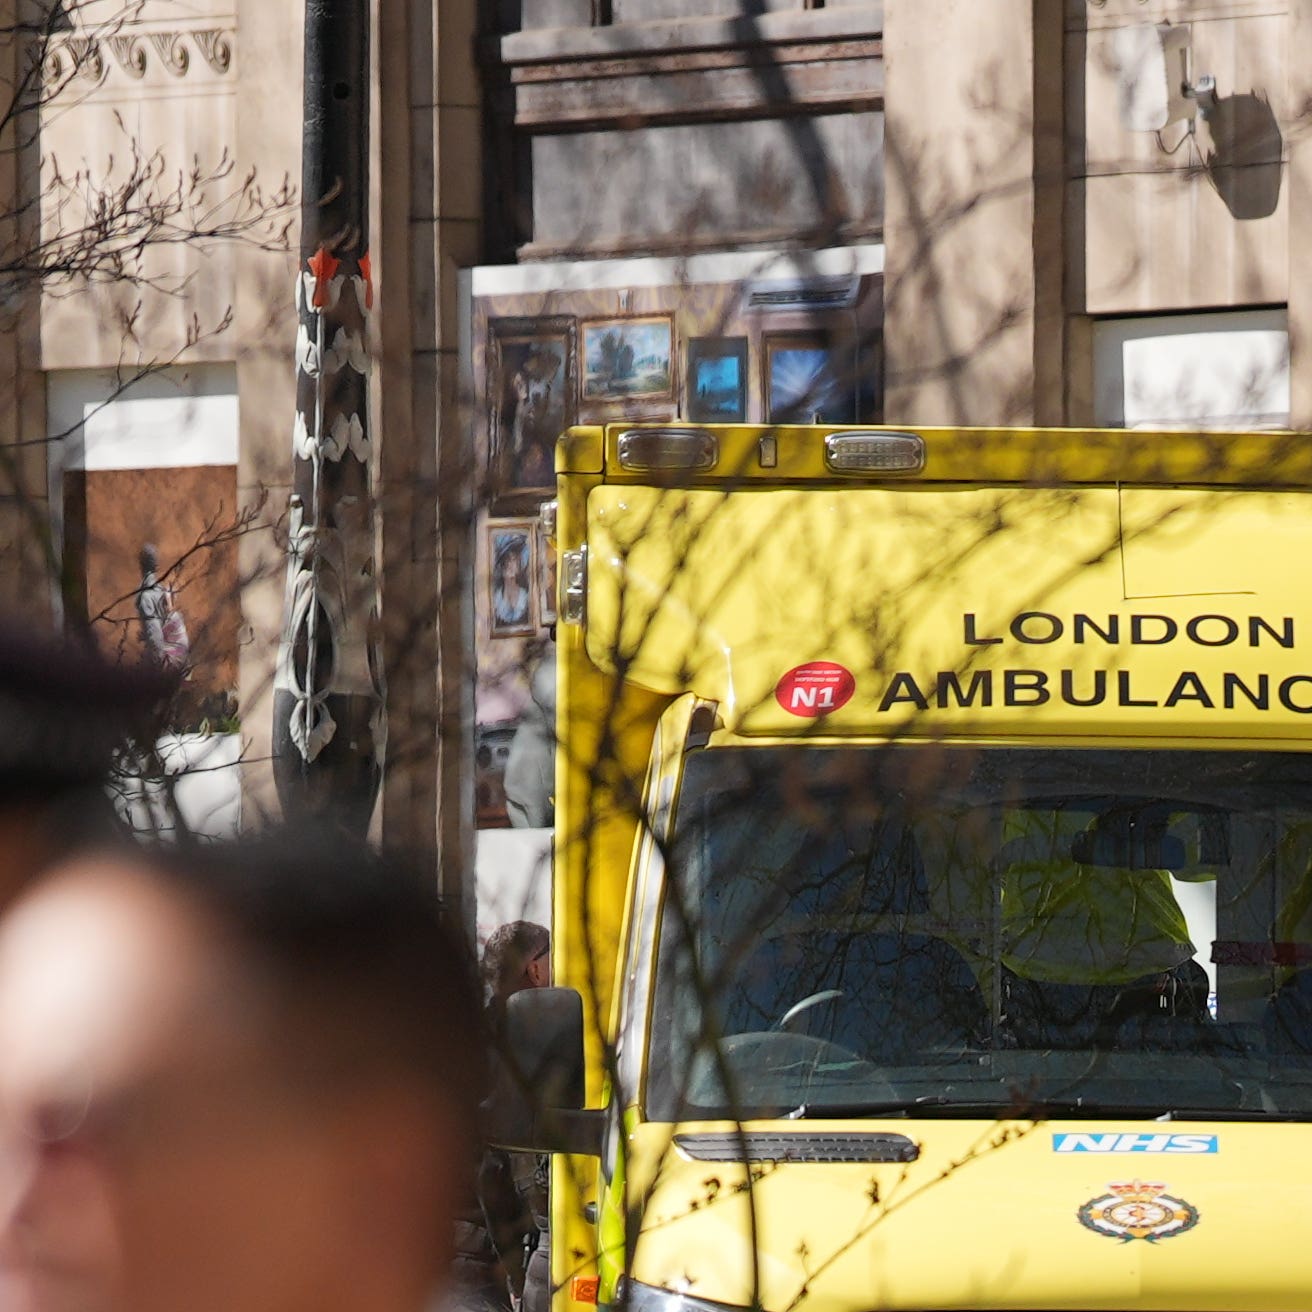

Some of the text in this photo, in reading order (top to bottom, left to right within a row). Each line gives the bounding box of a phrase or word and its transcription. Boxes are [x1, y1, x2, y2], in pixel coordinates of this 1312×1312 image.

[963, 612, 1294, 648] LONDON
[791, 687, 834, 708] N1
[1057, 1134, 1213, 1152] NHS
